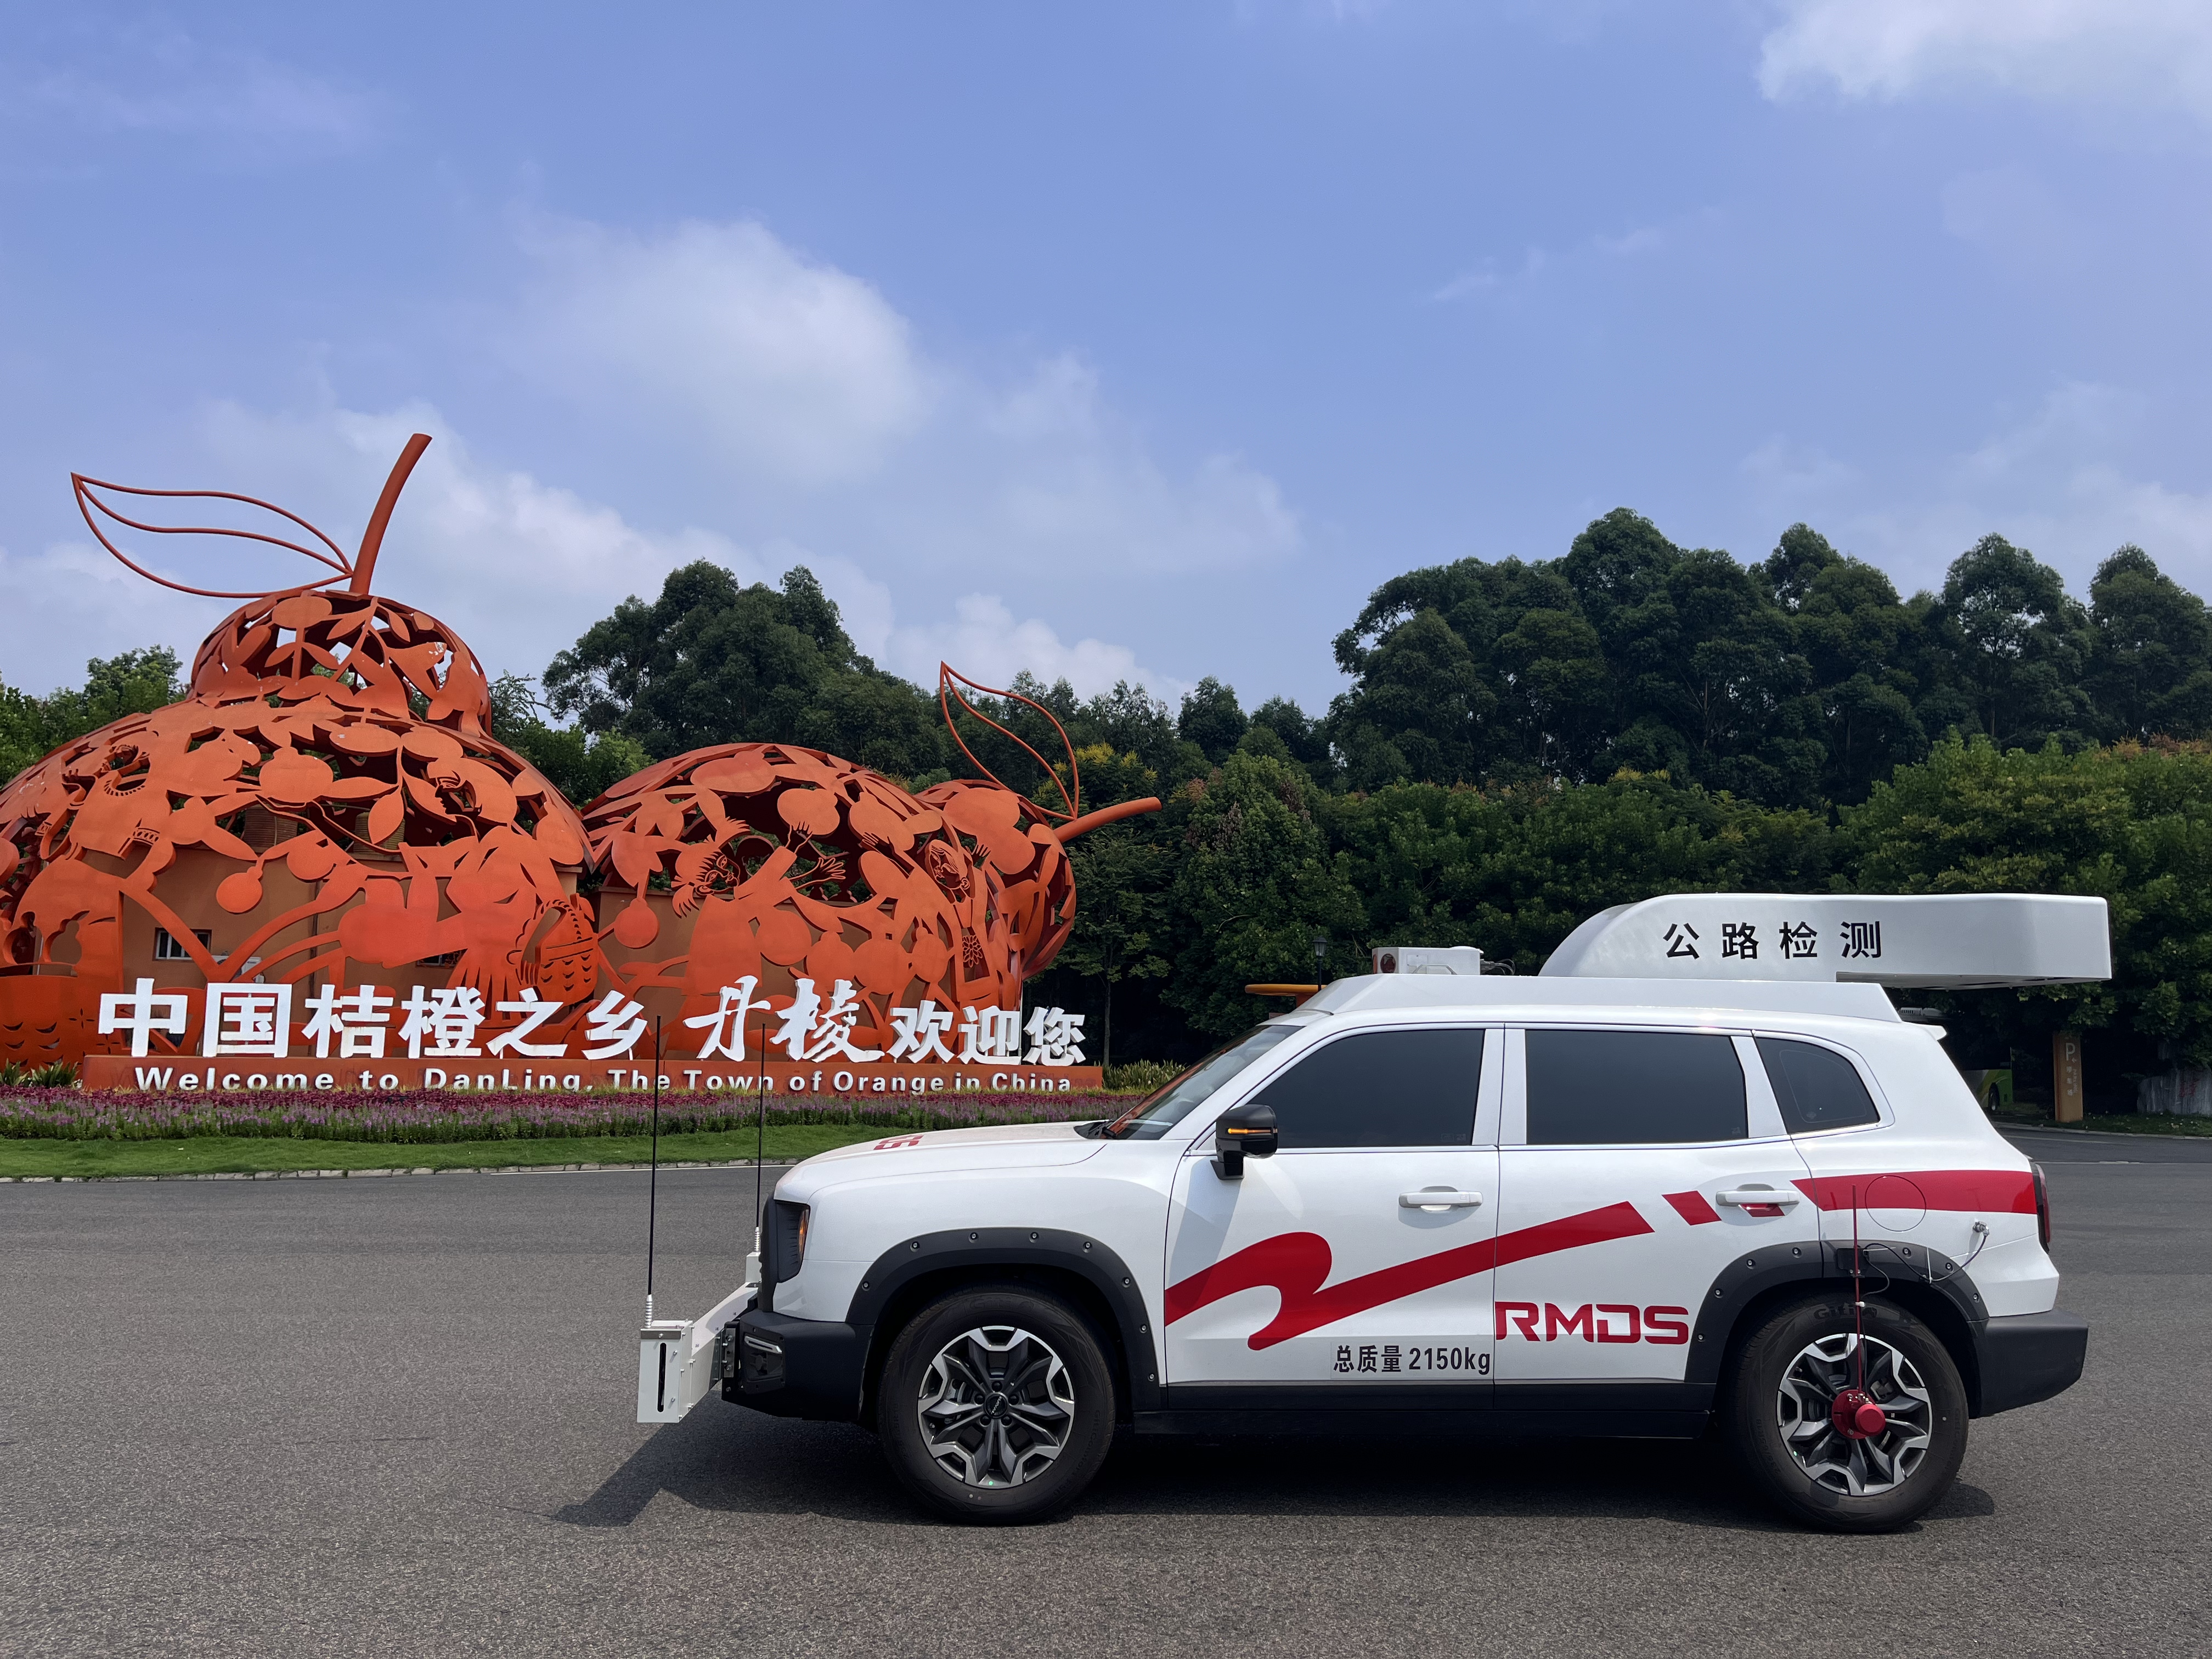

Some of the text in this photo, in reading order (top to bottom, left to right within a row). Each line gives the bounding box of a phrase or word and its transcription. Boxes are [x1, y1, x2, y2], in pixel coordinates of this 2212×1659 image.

[1663, 921, 1882, 960] 公路检测
[98, 978, 647, 1060] 中国桔橙之乡
[2066, 1042, 2075, 1061] P
[134, 1067, 334, 1090] Welcome
[359, 1070, 399, 1090] to
[607, 1069, 670, 1090] The
[682, 1069, 774, 1090] Town
[788, 1070, 822, 1091] of
[832, 1071, 944, 1096] Orange
[955, 1072, 980, 1091] in
[991, 1073, 1070, 1092] China
[1494, 1301, 1689, 1345] RMDS
[1813, 1305, 1855, 1320] Giti
[1333, 1345, 1490, 1375] 总质量 2150kg
